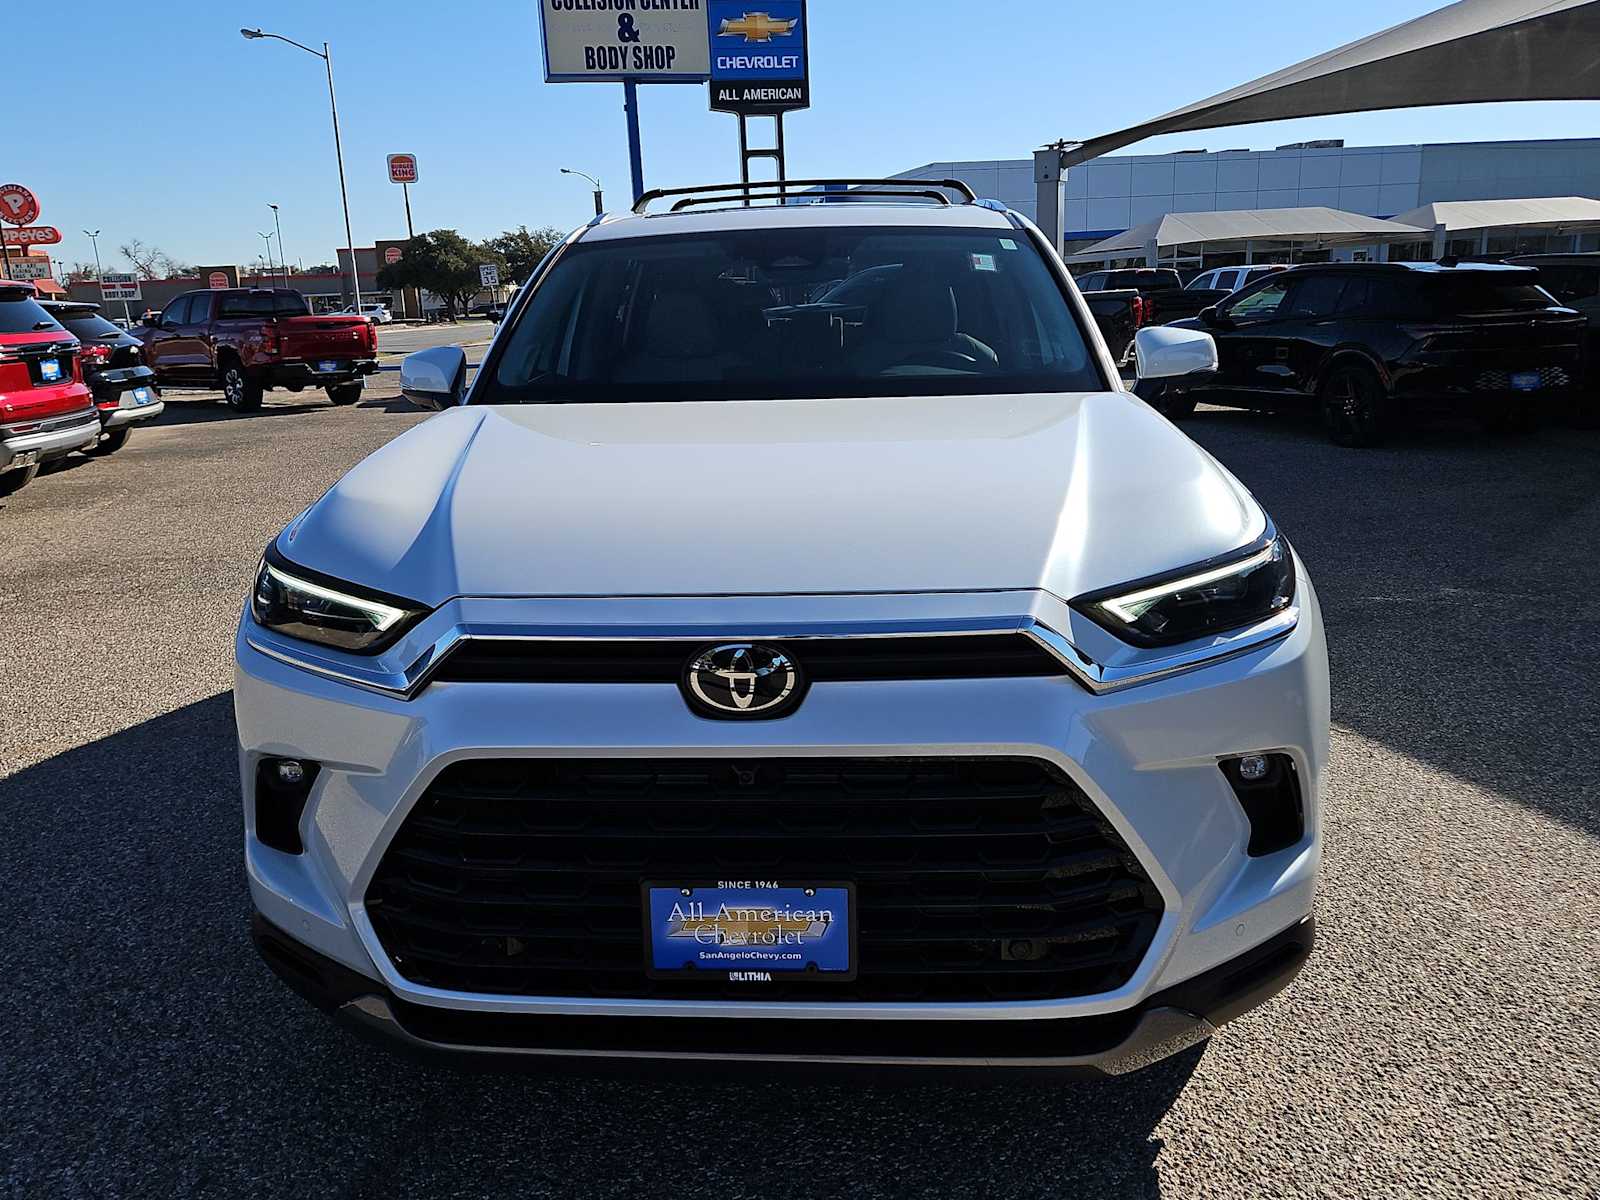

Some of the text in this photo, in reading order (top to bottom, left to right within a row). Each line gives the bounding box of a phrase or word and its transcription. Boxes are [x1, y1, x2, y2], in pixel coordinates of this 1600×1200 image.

[617, 12, 640, 42] &
[585, 46, 676, 70] BODY SHOP
[717, 55, 799, 69] CHEVROLET
[718, 87, 802, 101] ALL AMERICAN
[391, 169, 415, 177] KING
[3, 194, 25, 215] P
[483, 276, 497, 284] 35
[718, 881, 779, 889] SINCE 1946
[667, 902, 834, 922] All American
[694, 924, 805, 945] Chevrolet
[699, 951, 802, 962] SanAngeloChevy.com
[738, 971, 772, 982] LITHIA
